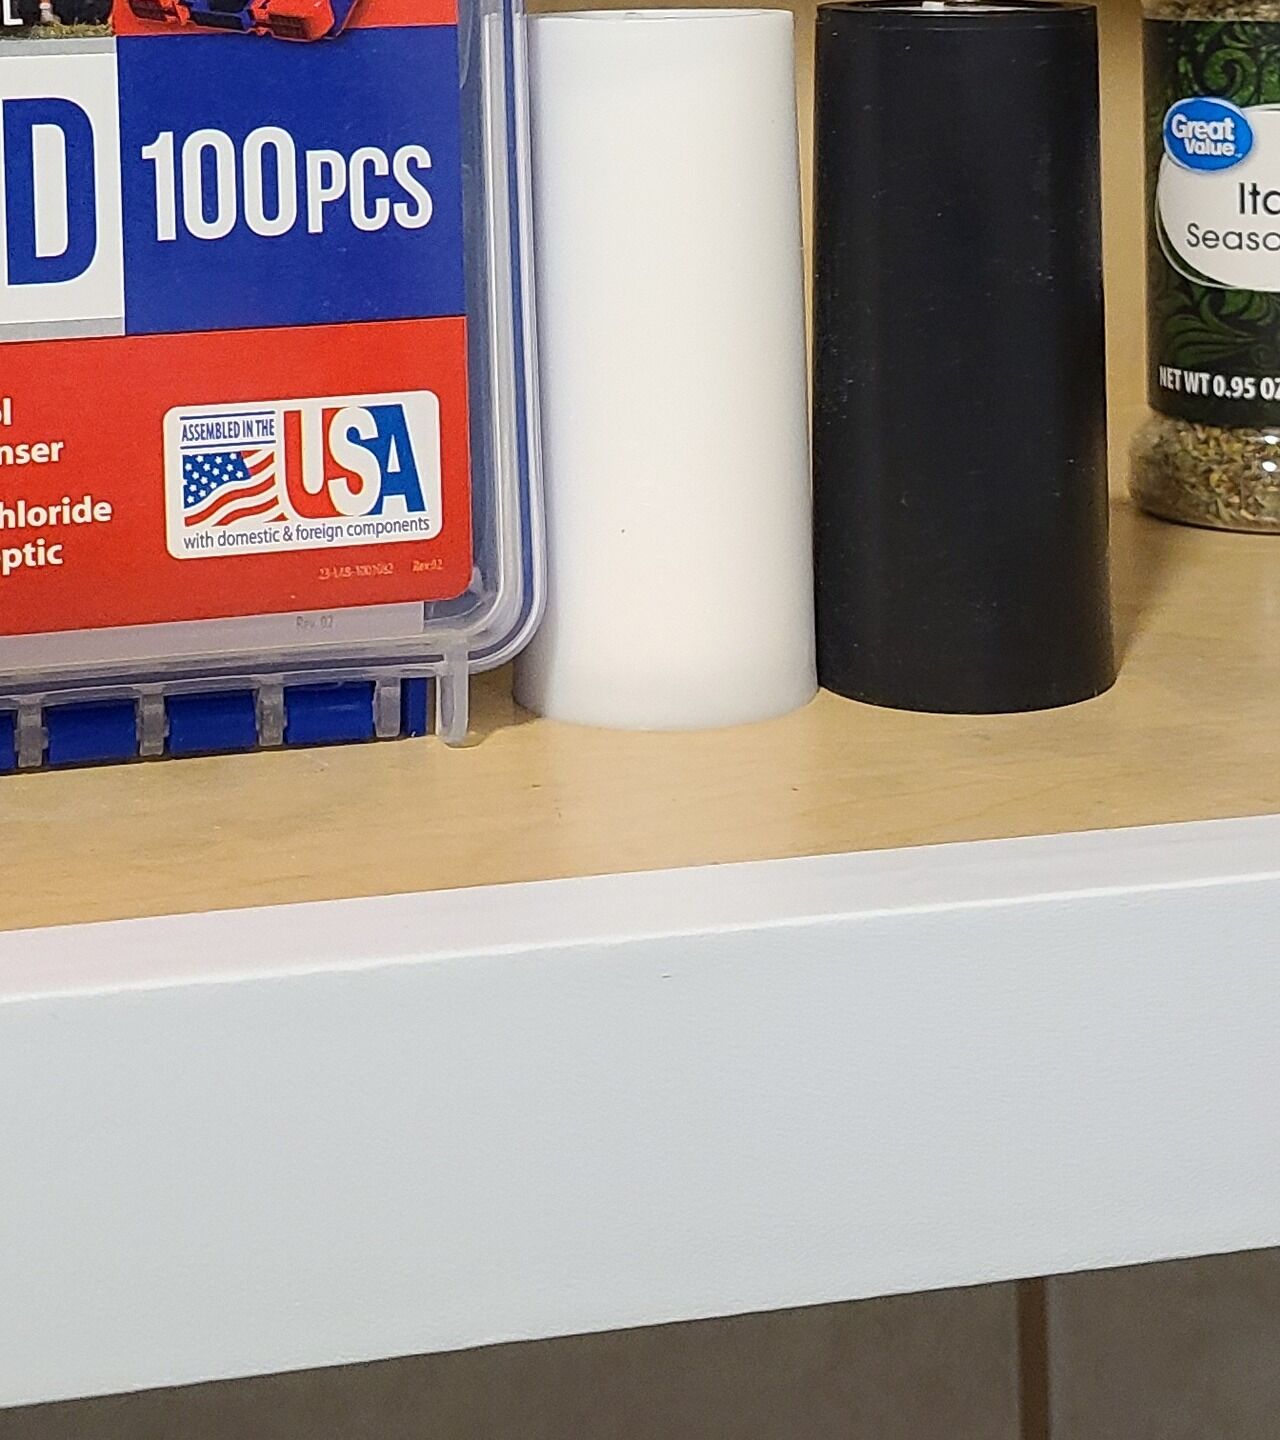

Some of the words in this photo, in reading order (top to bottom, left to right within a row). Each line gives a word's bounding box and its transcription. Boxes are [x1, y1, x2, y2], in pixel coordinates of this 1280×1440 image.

[1170, 113, 1235, 141] Great
[1184, 138, 1235, 157] Value
[1159, 365, 1182, 392] NET
[1182, 370, 1210, 397] WT
[1212, 374, 1256, 399] 0.95
[181, 421, 241, 442] ASSEMBLED
[242, 419, 254, 438] IN
[255, 418, 275, 438] THE
[283, 403, 427, 520] USA
[183, 529, 214, 550] with
[217, 527, 280, 548] domestic
[295, 522, 344, 543] foreign
[346, 517, 430, 541] components
